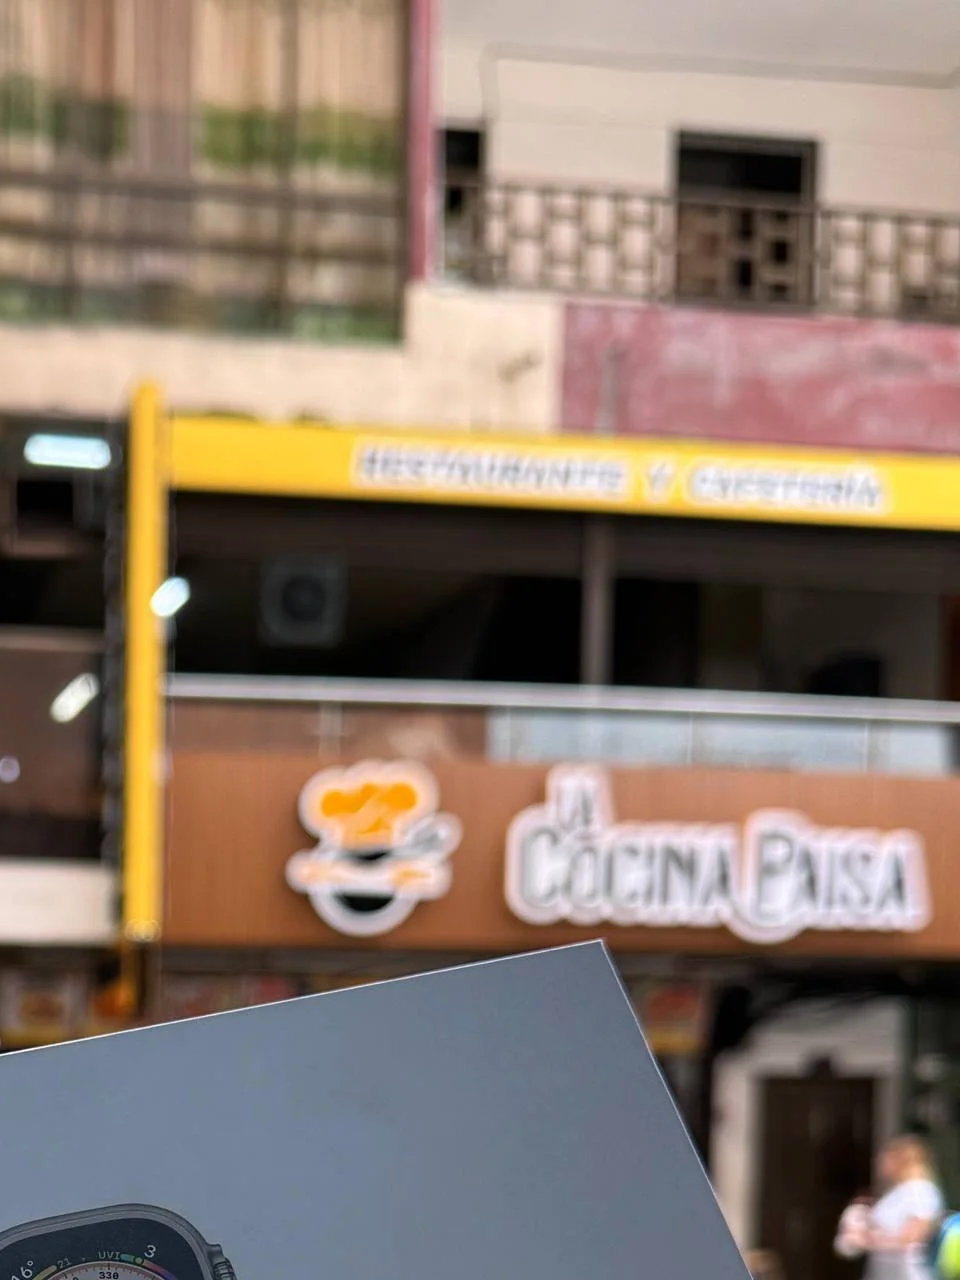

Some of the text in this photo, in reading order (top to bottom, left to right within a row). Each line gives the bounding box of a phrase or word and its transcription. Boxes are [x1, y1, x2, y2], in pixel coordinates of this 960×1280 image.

[98, 1250, 121, 1260] UVI
[144, 1244, 156, 1258] 3
[98, 1271, 119, 1280] 330
